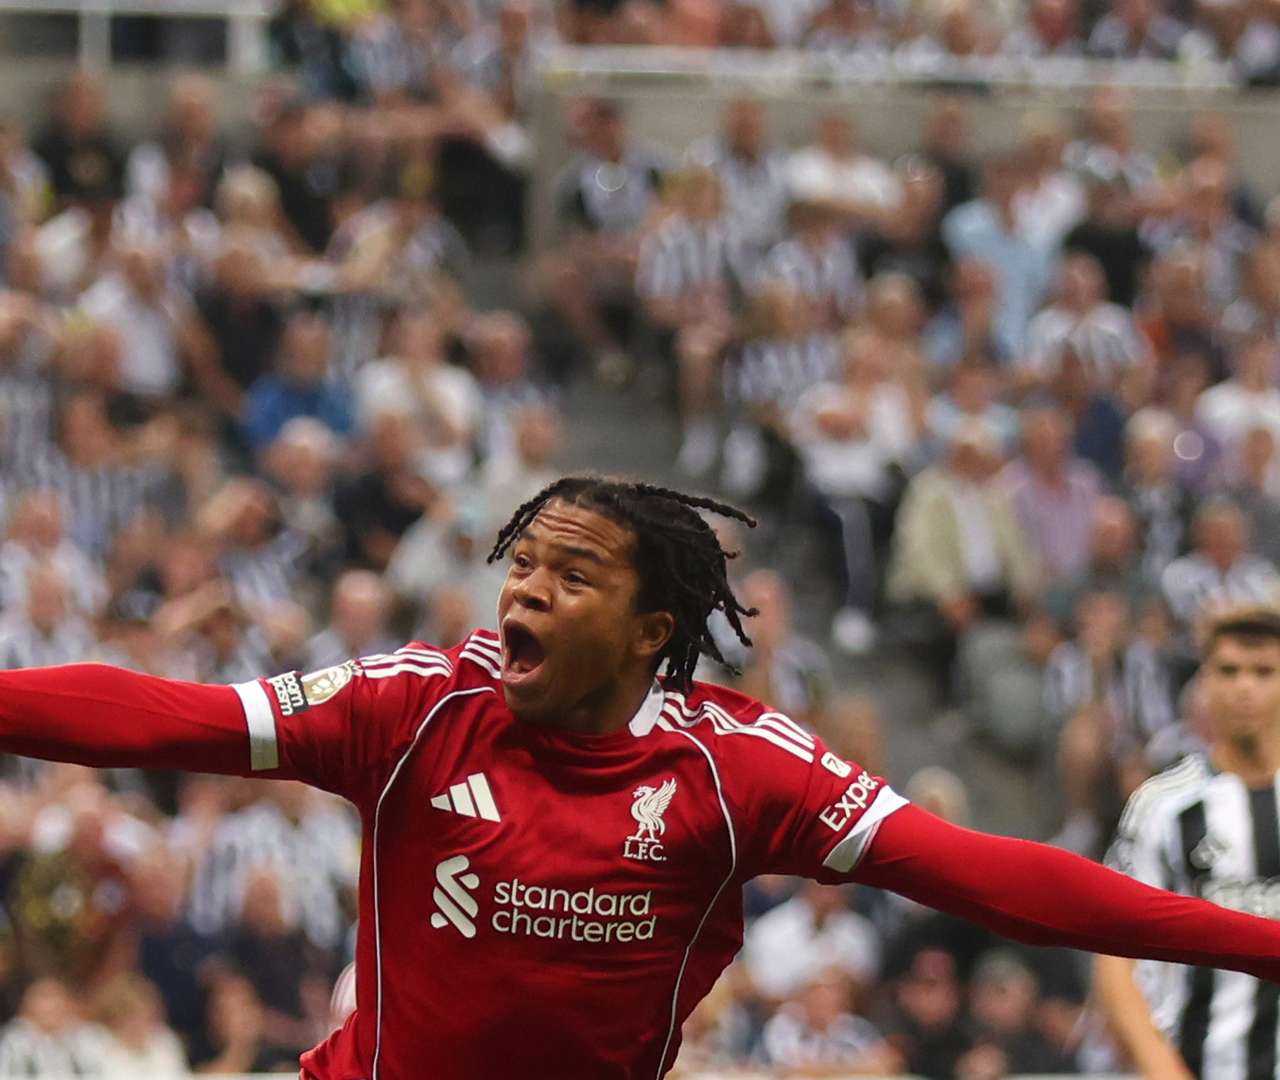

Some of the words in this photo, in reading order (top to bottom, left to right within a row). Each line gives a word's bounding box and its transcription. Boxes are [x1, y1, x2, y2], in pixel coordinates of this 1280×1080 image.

[623, 841, 667, 862] L.F.C.
[494, 879, 652, 916] standard
[492, 908, 657, 942] chartered
